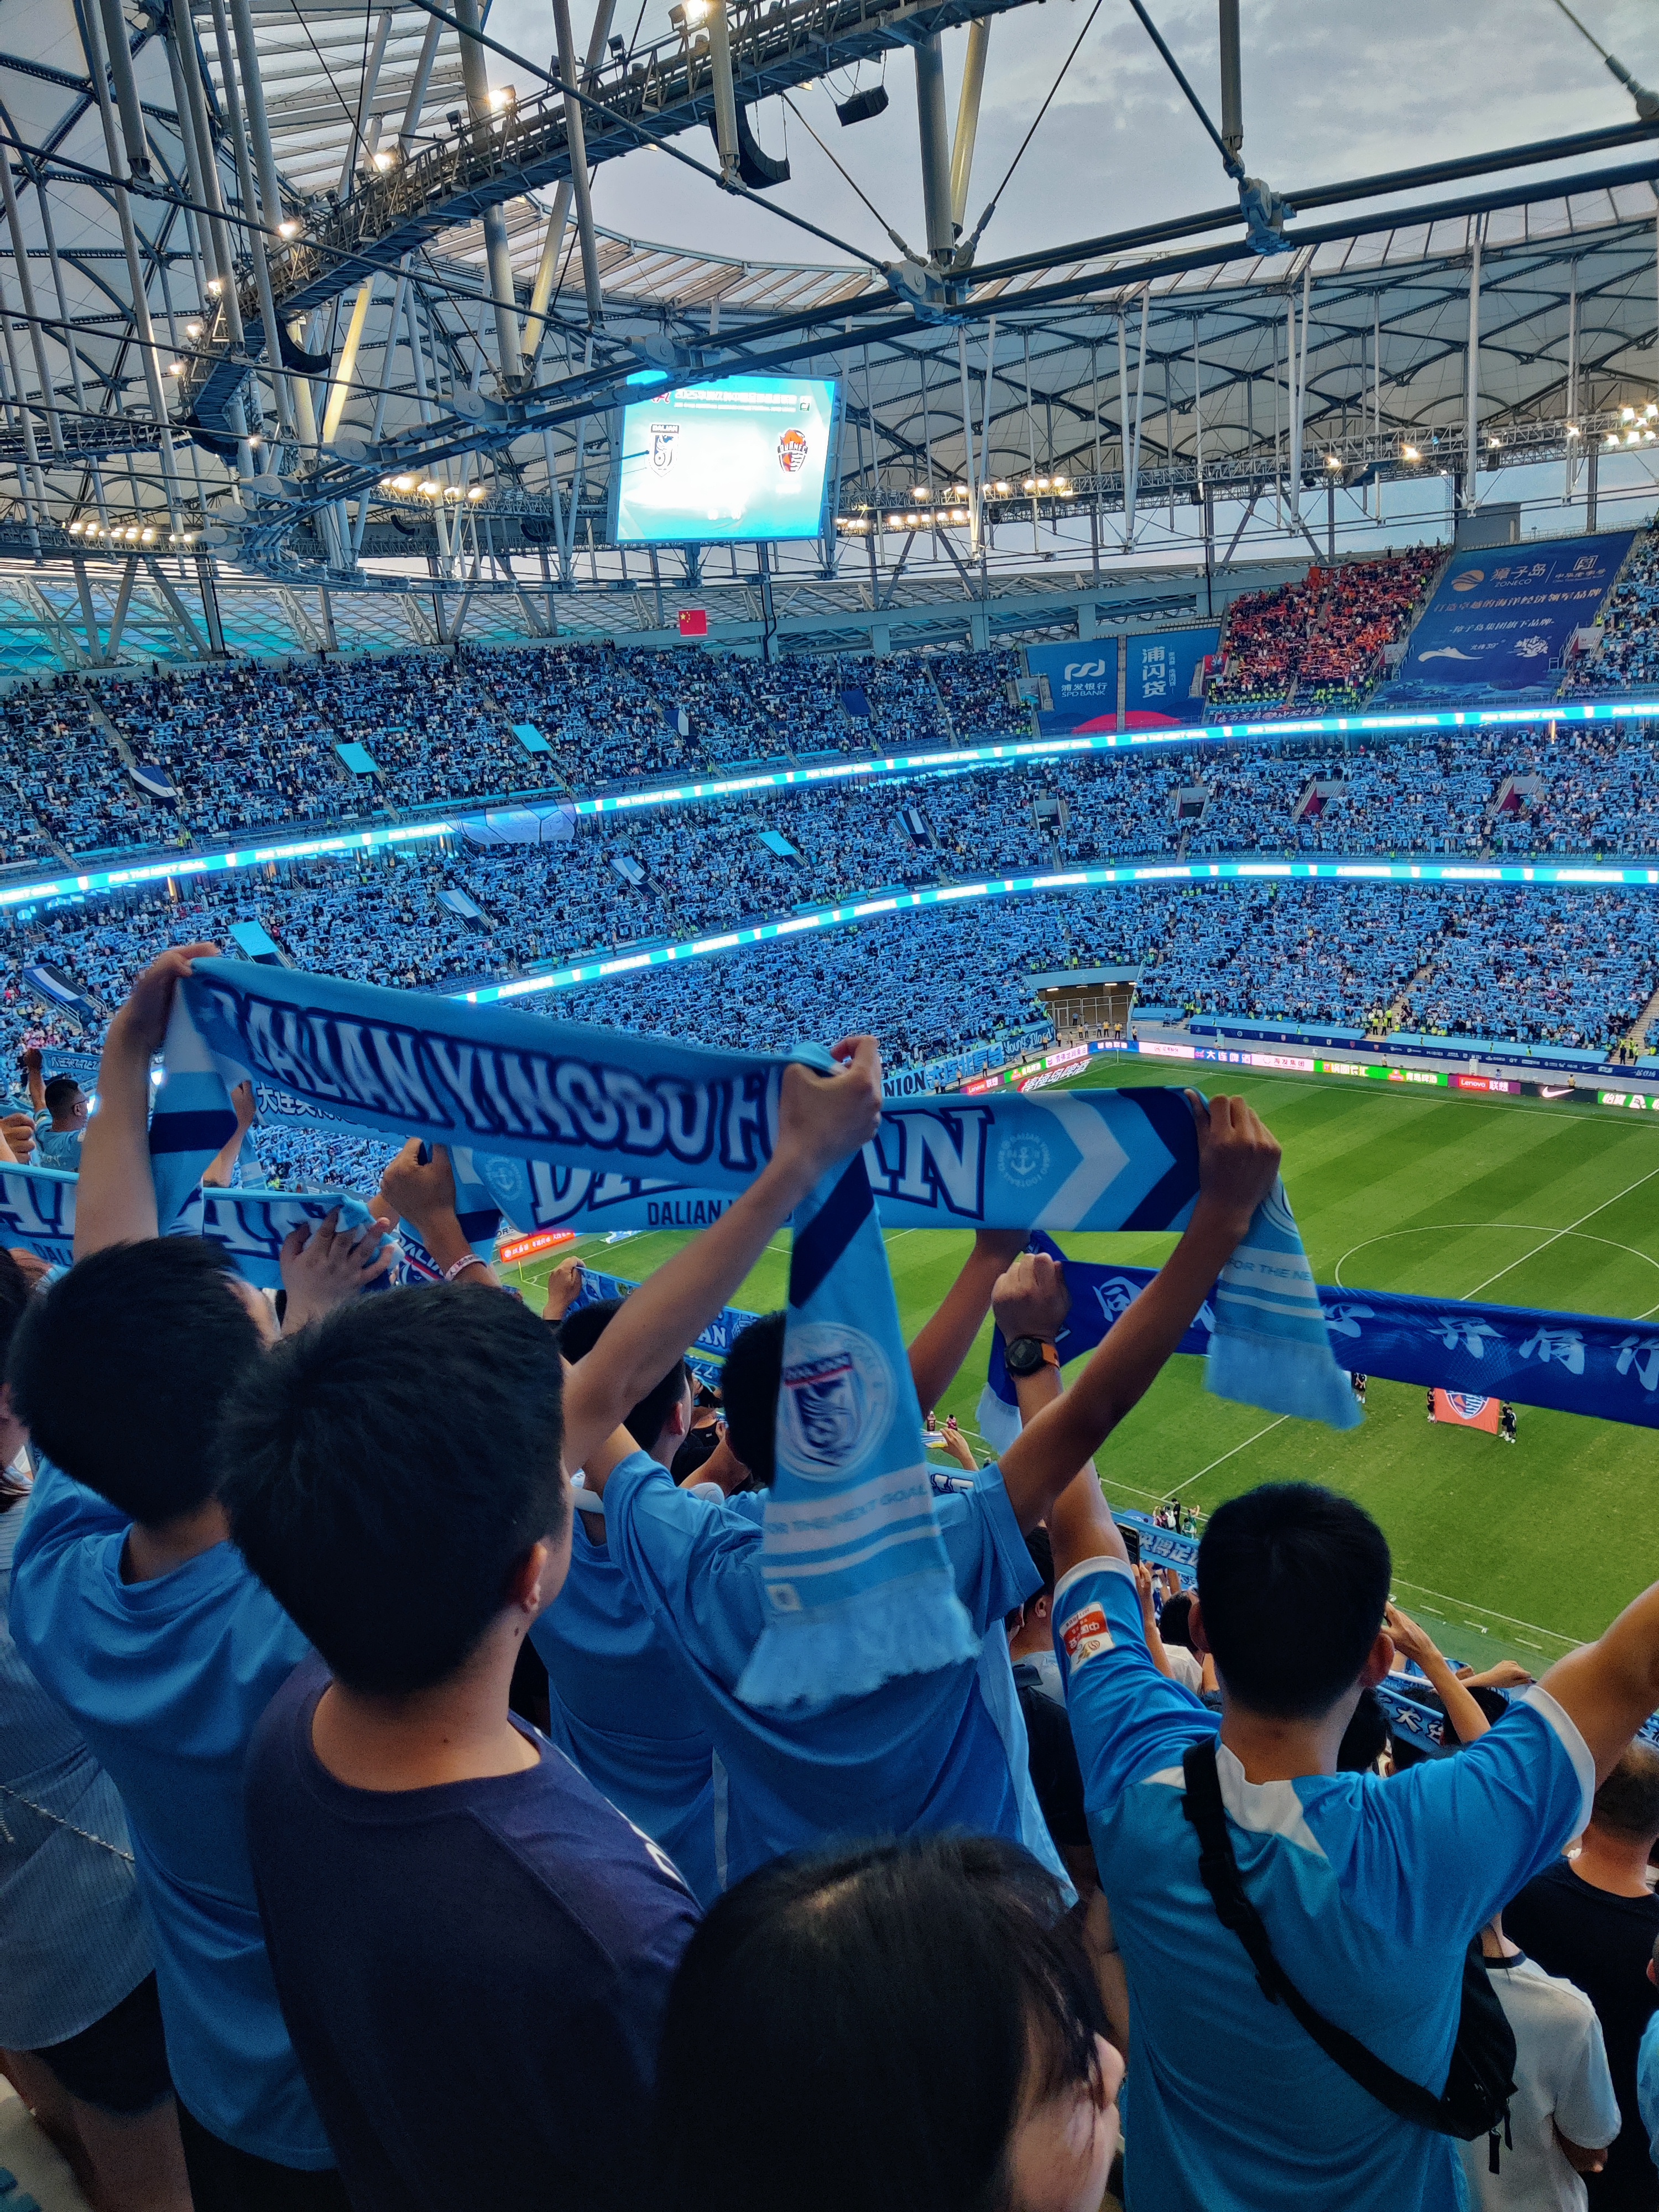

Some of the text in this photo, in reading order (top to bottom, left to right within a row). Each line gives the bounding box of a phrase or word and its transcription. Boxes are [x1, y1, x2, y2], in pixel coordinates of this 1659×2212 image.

[1494, 578, 1532, 588] ZONECO
[1142, 646, 1166, 698] 浦闪贷
[1061, 682, 1108, 692] 浦发银行
[1206, 1050, 1251, 1064] 大连啤酒
[1331, 1063, 1369, 1077] 锅圈食汇
[1460, 1079, 1509, 1093] Lenovo 联想
[647, 1199, 722, 1225] DALIAN
[1259, 1263, 1291, 1279] THE
